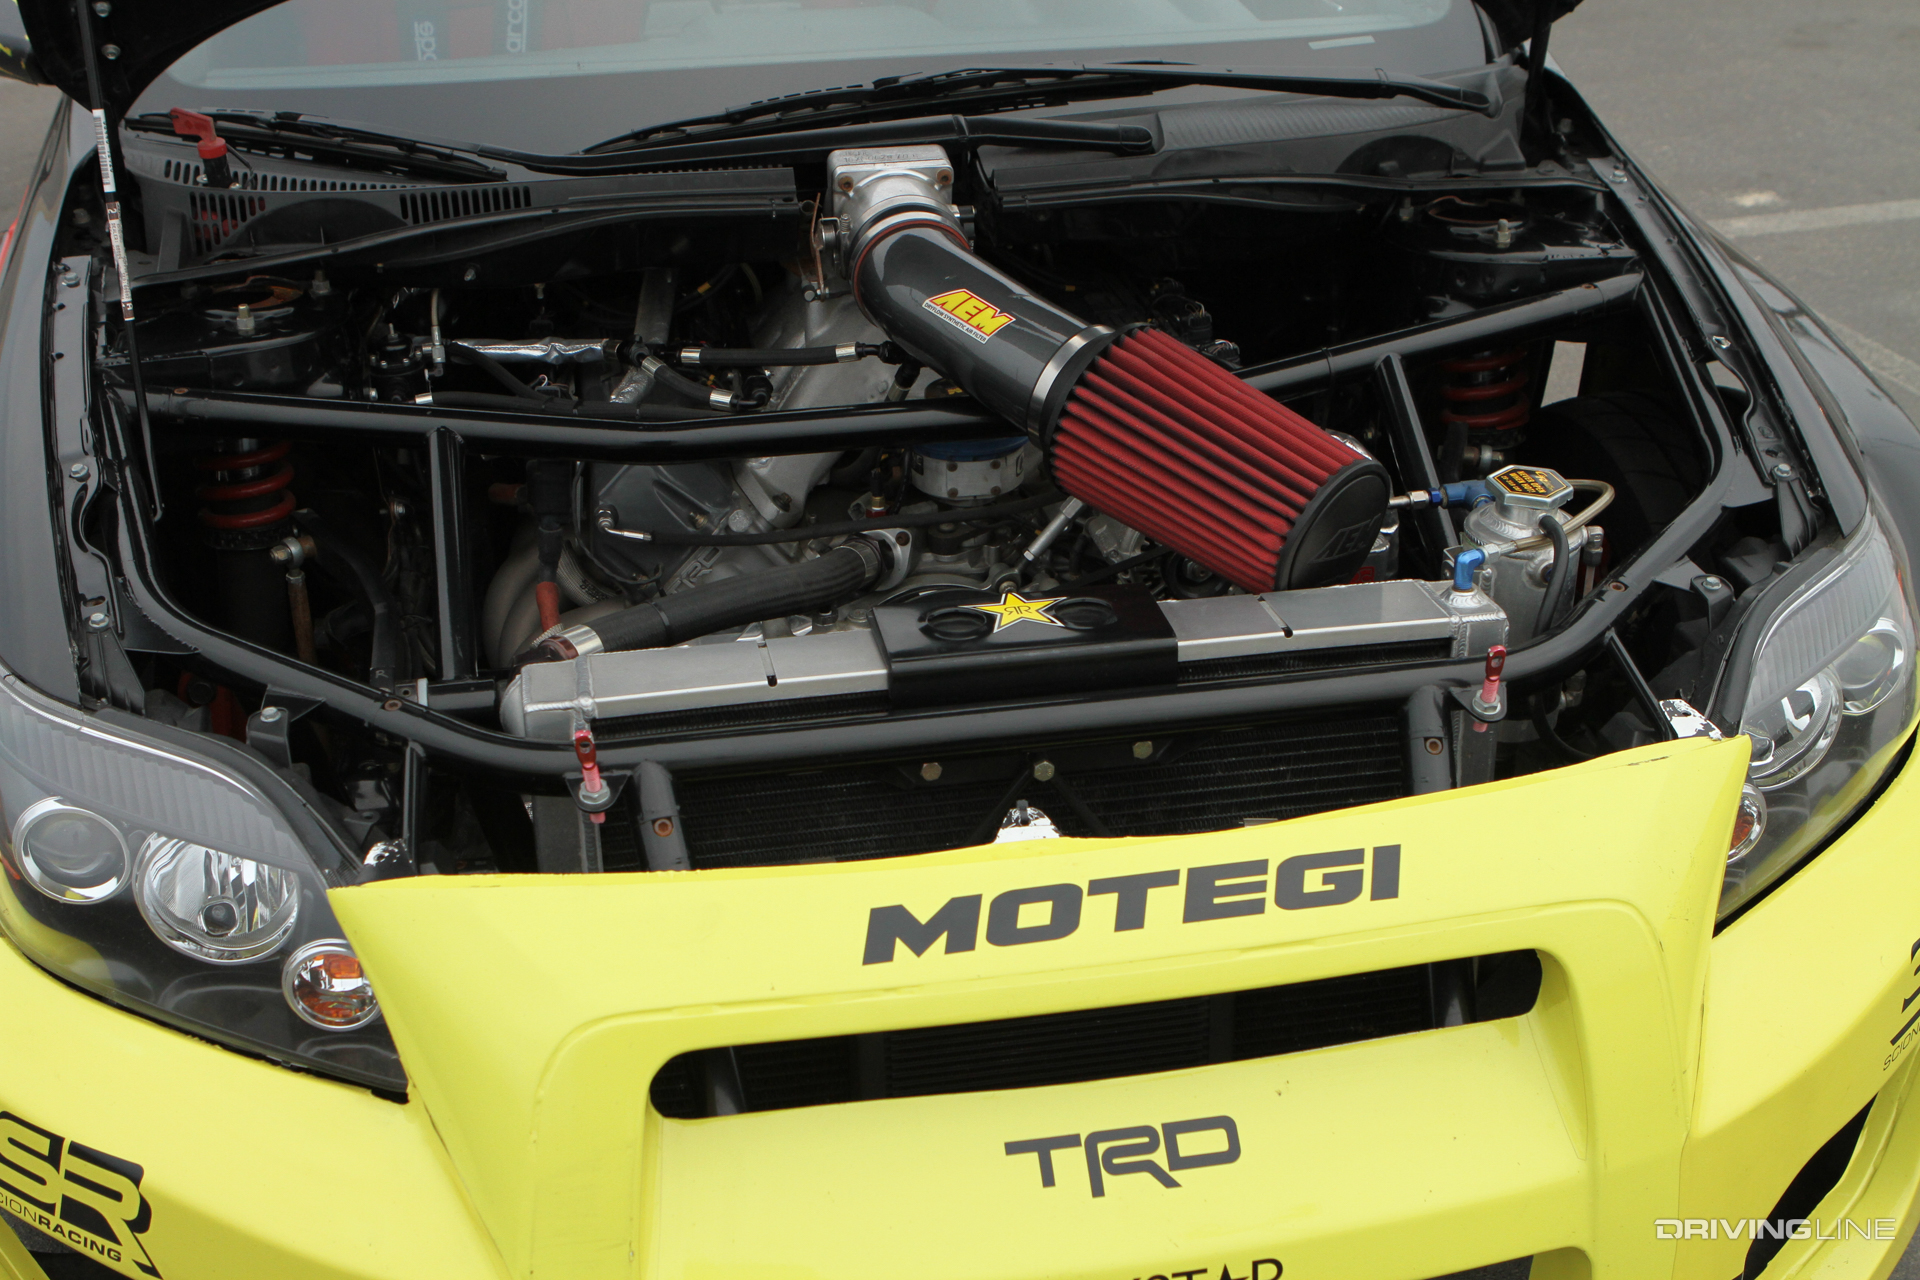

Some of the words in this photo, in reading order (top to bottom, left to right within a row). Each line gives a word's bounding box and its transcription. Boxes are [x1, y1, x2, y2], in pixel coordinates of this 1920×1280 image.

[924, 302, 944, 317] DRYFLOW
[944, 313, 966, 331] SYNTHETIC
[966, 326, 974, 335] AIR
[973, 331, 987, 343] FILTER
[929, 289, 1014, 337] AEM
[862, 844, 1402, 966] MOTEGI
[1004, 1115, 1241, 1198] TRD
